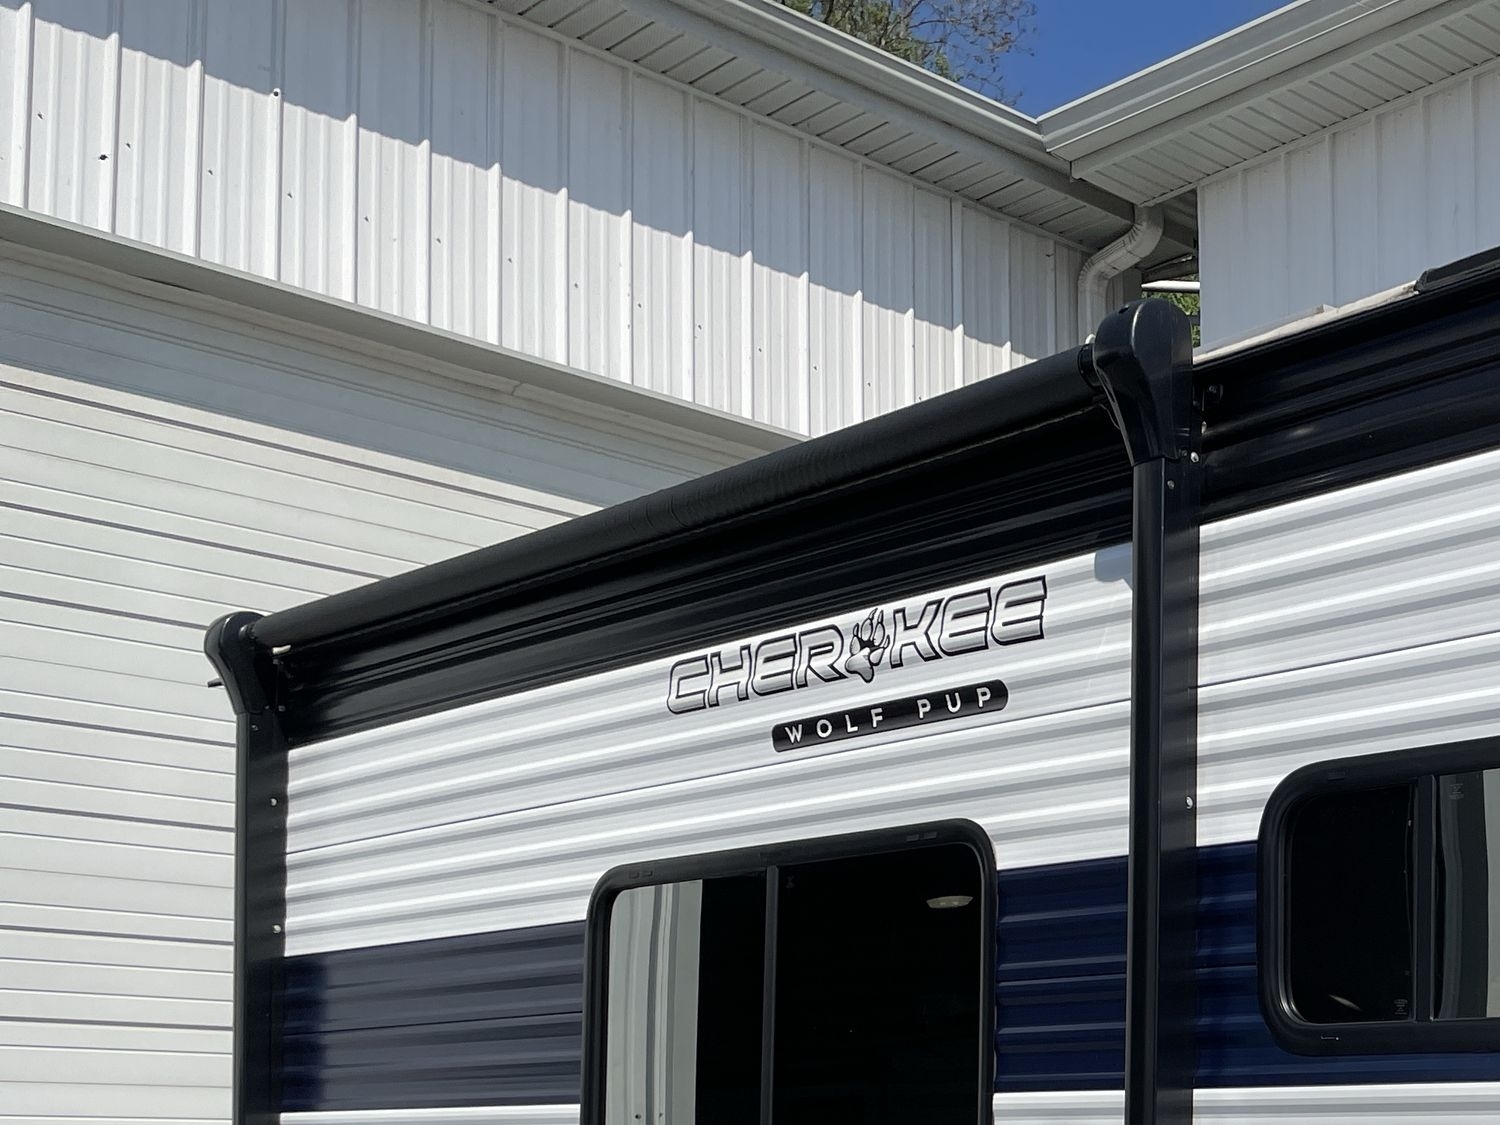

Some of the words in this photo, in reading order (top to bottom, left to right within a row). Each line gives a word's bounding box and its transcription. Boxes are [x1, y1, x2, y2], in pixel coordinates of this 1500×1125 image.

[666, 575, 1048, 714] CHEROKEE
[784, 707, 885, 744] WOLF
[918, 687, 993, 720] PUP
